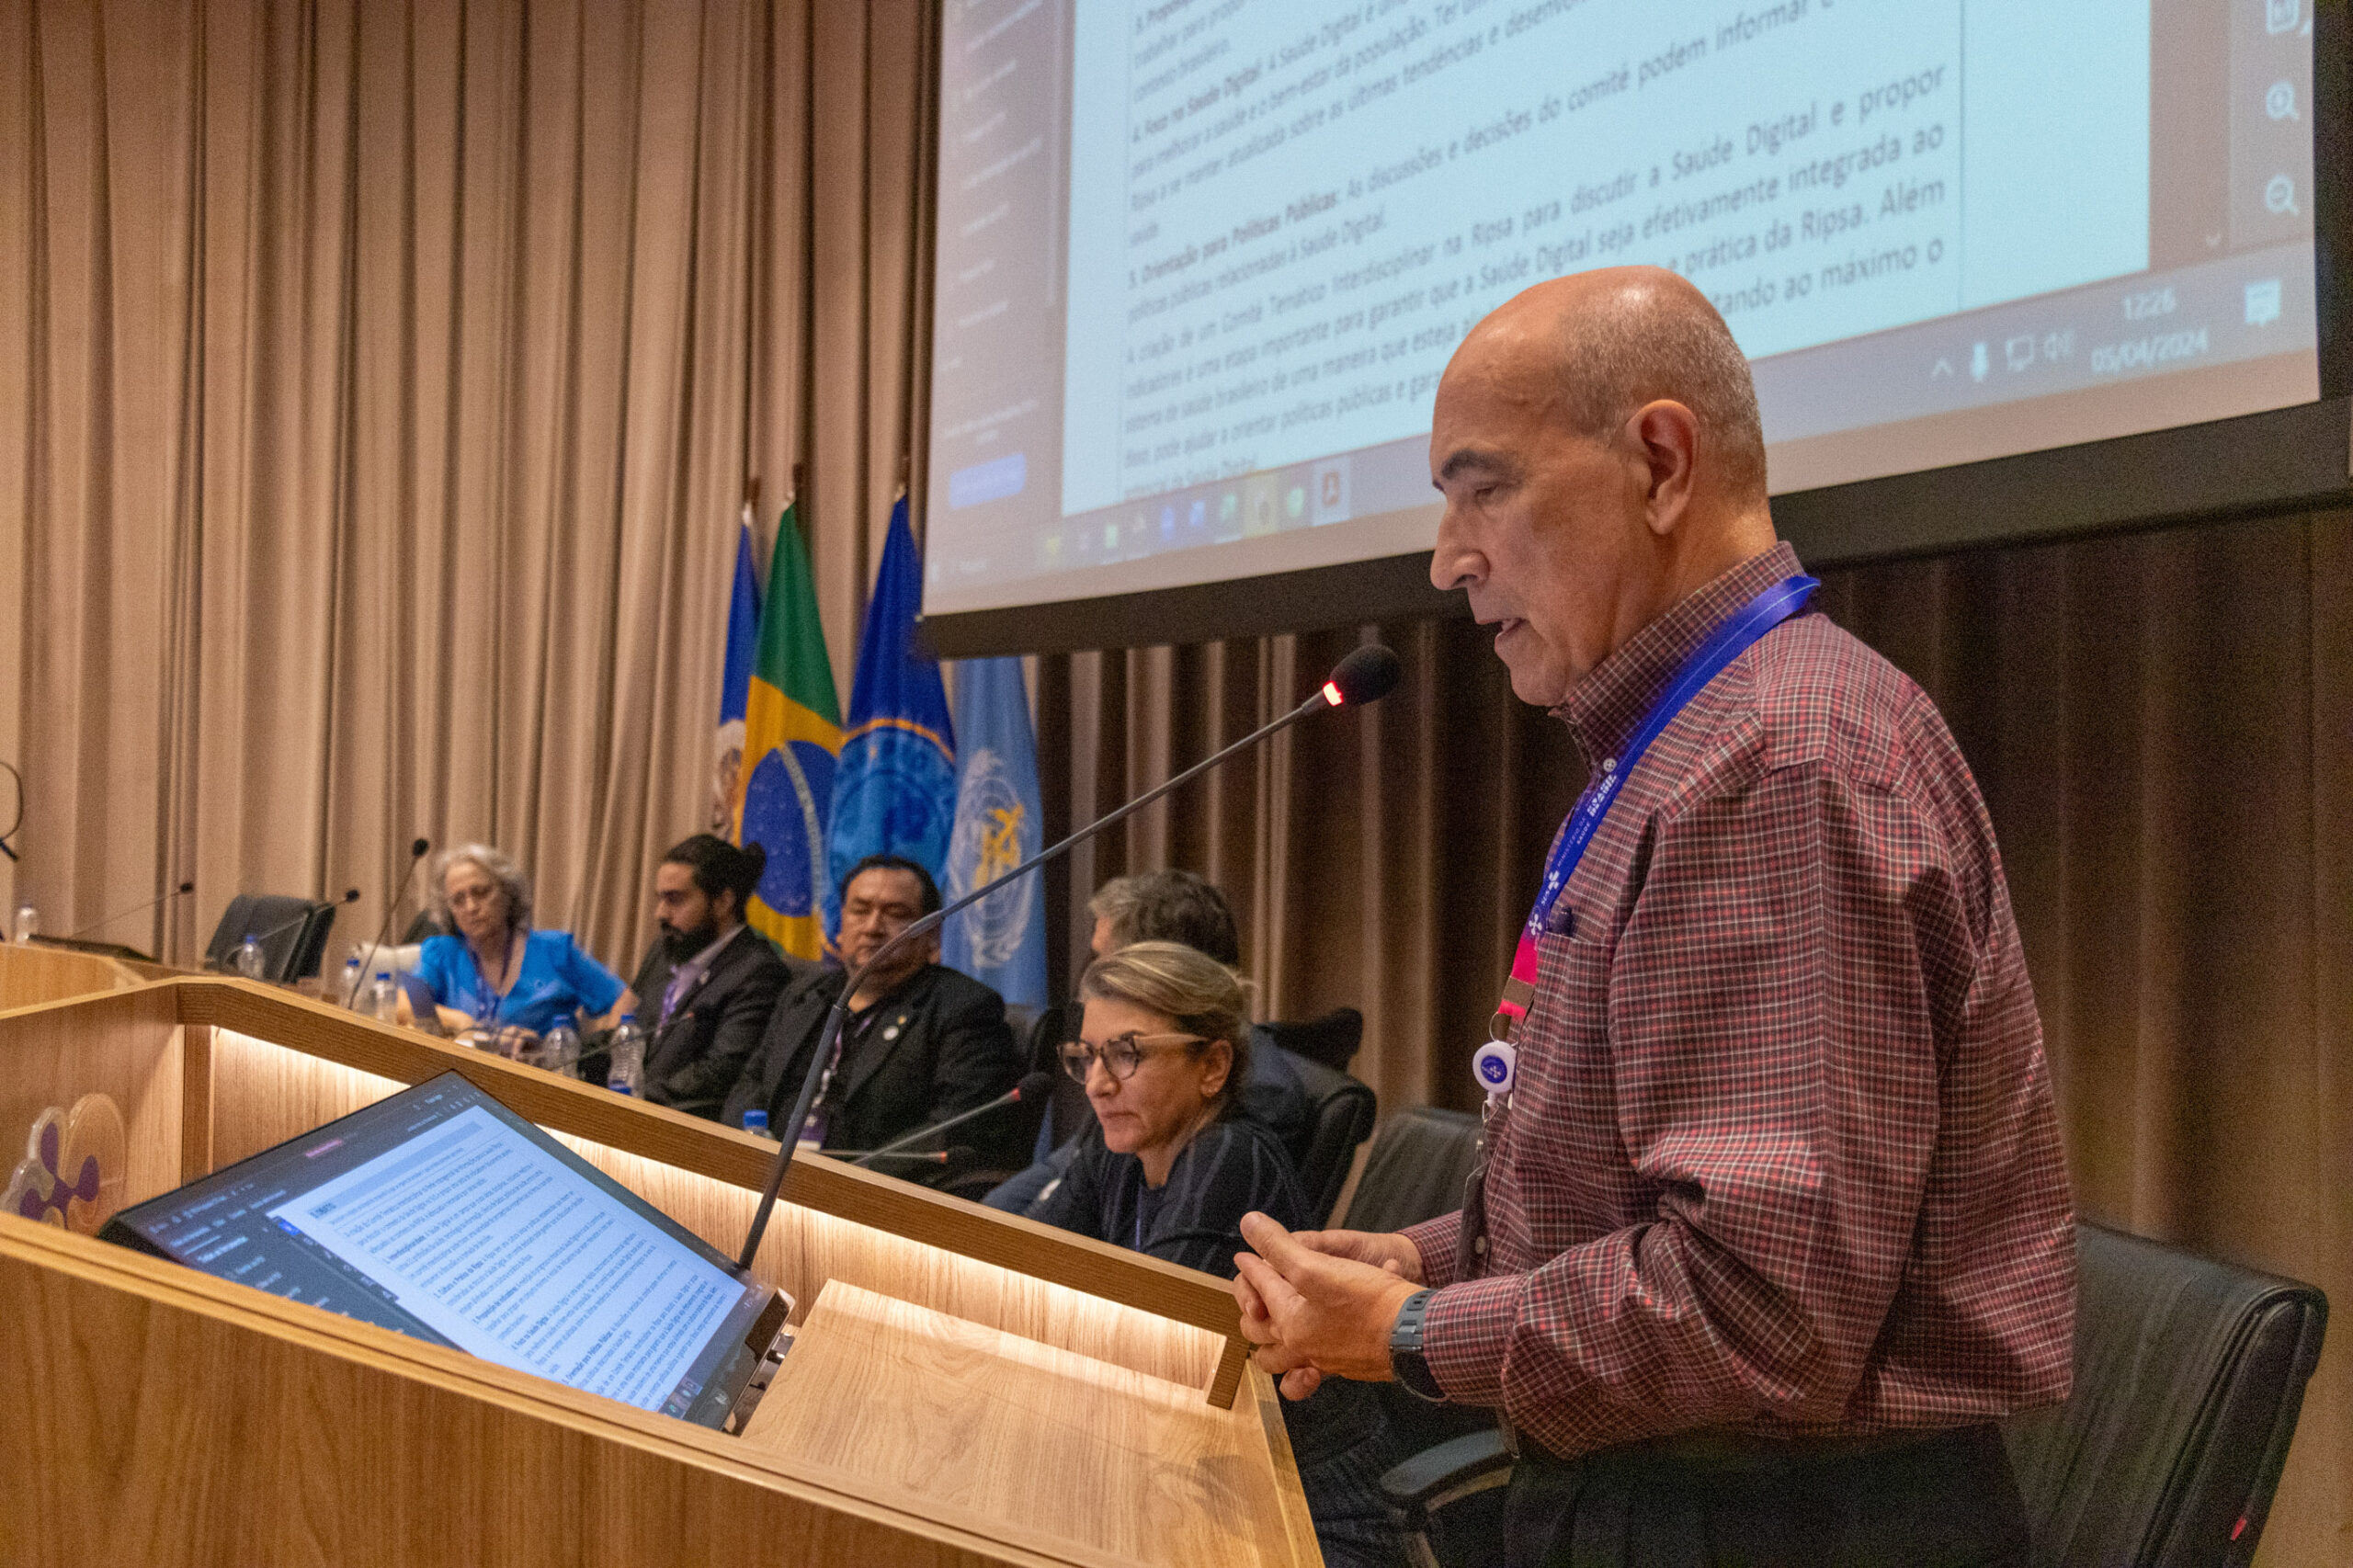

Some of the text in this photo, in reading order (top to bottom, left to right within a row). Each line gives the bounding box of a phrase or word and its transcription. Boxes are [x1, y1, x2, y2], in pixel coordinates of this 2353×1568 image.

[1639, 38, 1706, 88] podem
[1523, 200, 1561, 233] para
[1747, 102, 1816, 155] Digital
[1859, 66, 1945, 123] propor
[1537, 230, 1590, 272] Digital
[1598, 223, 1635, 253] seja
[1643, 177, 1779, 239] efetivamente
[1789, 134, 1901, 191] integrada
[1913, 124, 1944, 154] ao
[1765, 220, 1792, 253] da
[1880, 180, 1944, 217] Além
[1784, 273, 1812, 301] ao
[1822, 244, 1917, 289] máximo
[1586, 774, 1618, 817] BRASIL
